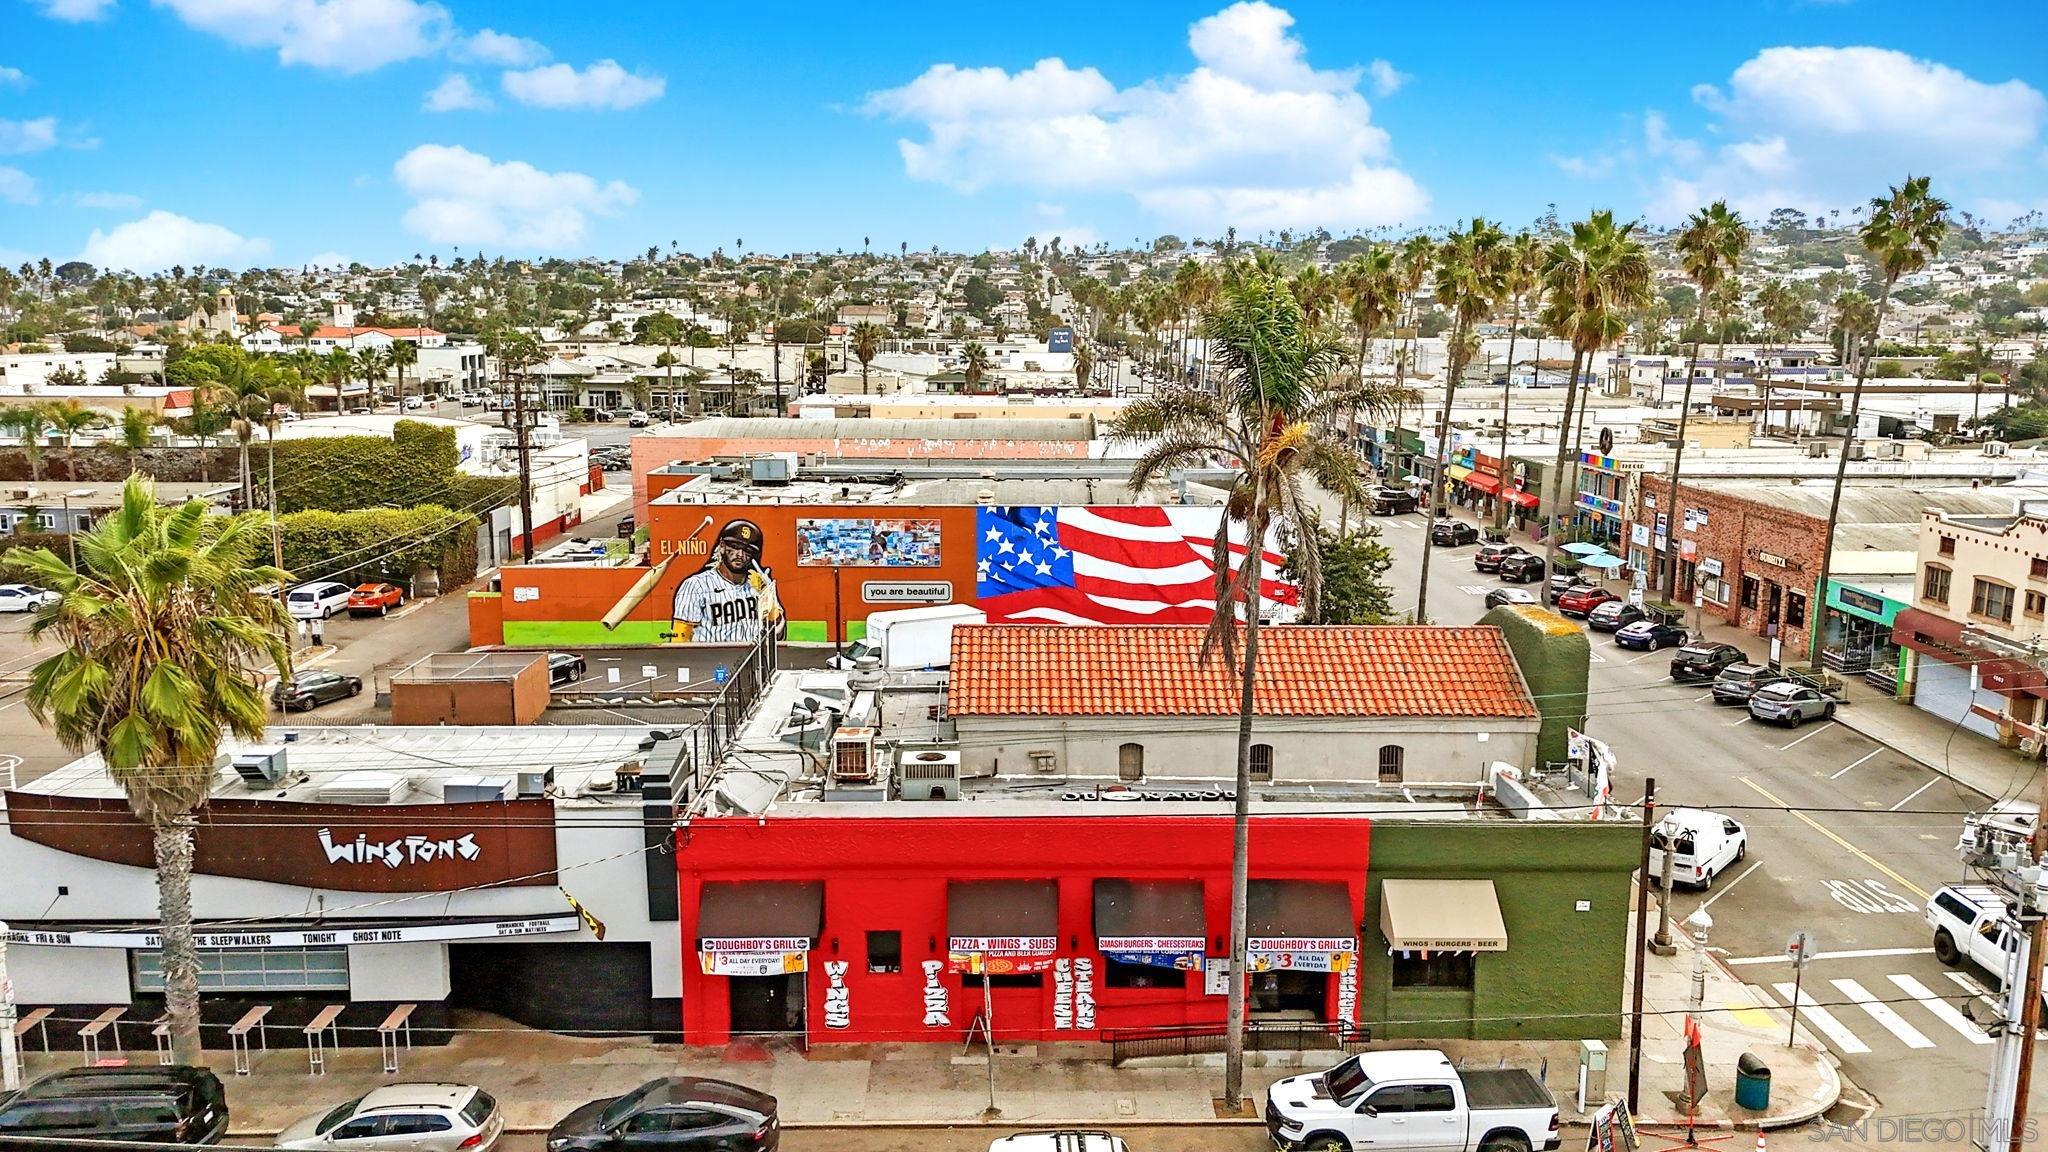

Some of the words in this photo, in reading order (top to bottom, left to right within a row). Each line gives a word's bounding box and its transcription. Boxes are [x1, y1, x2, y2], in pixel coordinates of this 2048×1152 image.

[660, 540, 674, 555] EL
[677, 538, 707, 555] NIÑO
[870, 588, 887, 597] you
[889, 588, 904, 596] are
[906, 587, 945, 596] beautiful
[710, 597, 758, 626] PADR
[35, 935, 48, 943] FRI
[56, 935, 71, 944] SUN
[192, 936, 207, 946] THE
[210, 934, 272, 945] SLEEPWALKERS
[302, 933, 336, 943] TONIGHT
[352, 931, 379, 941] GHOST
[381, 930, 402, 940] NOTE
[951, 938, 980, 949] PIZZA
[987, 938, 1021, 949] WINGS
[1028, 938, 1055, 949] SUBS
[715, 940, 772, 950] DOUGHBOY'S
[773, 939, 797, 949] GRILL
[1099, 940, 1123, 949] SMASH
[1124, 940, 1153, 948] BURGERS
[1157, 940, 1204, 949] CHEESESTEAKS
[1261, 940, 1316, 950] DOUGHBOY'S
[1317, 940, 1342, 950] GRILL
[1293, 961, 1328, 969] EVERYDAY
